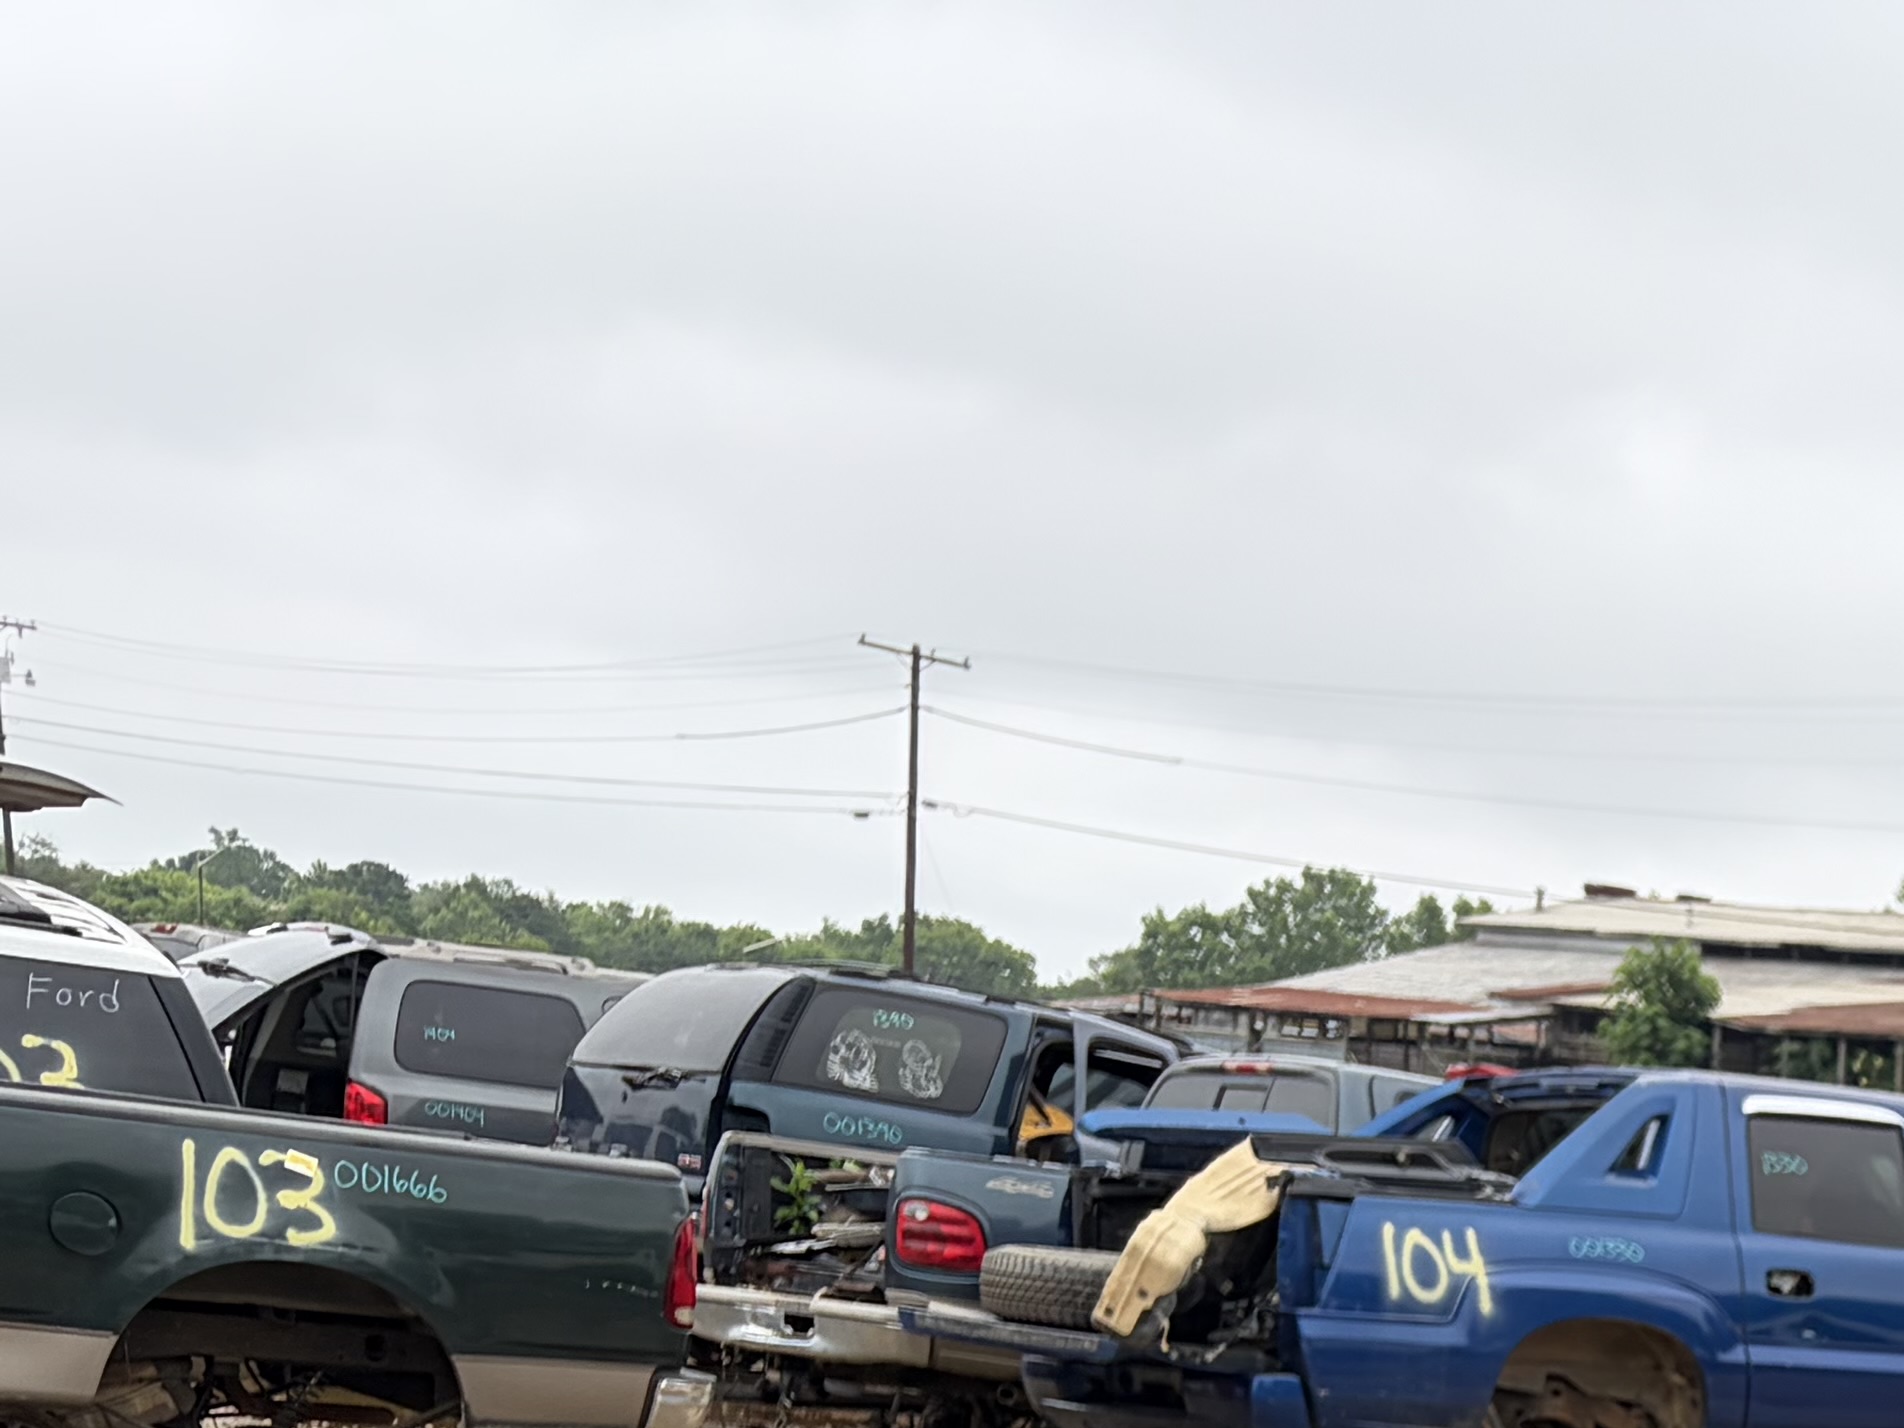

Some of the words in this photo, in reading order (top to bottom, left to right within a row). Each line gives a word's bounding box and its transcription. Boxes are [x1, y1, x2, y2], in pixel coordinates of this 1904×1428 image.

[26, 971, 120, 1013] Ford
[179, 1137, 337, 1251] 103
[334, 1159, 448, 1204] 001666
[1382, 1221, 1493, 1317] 104
